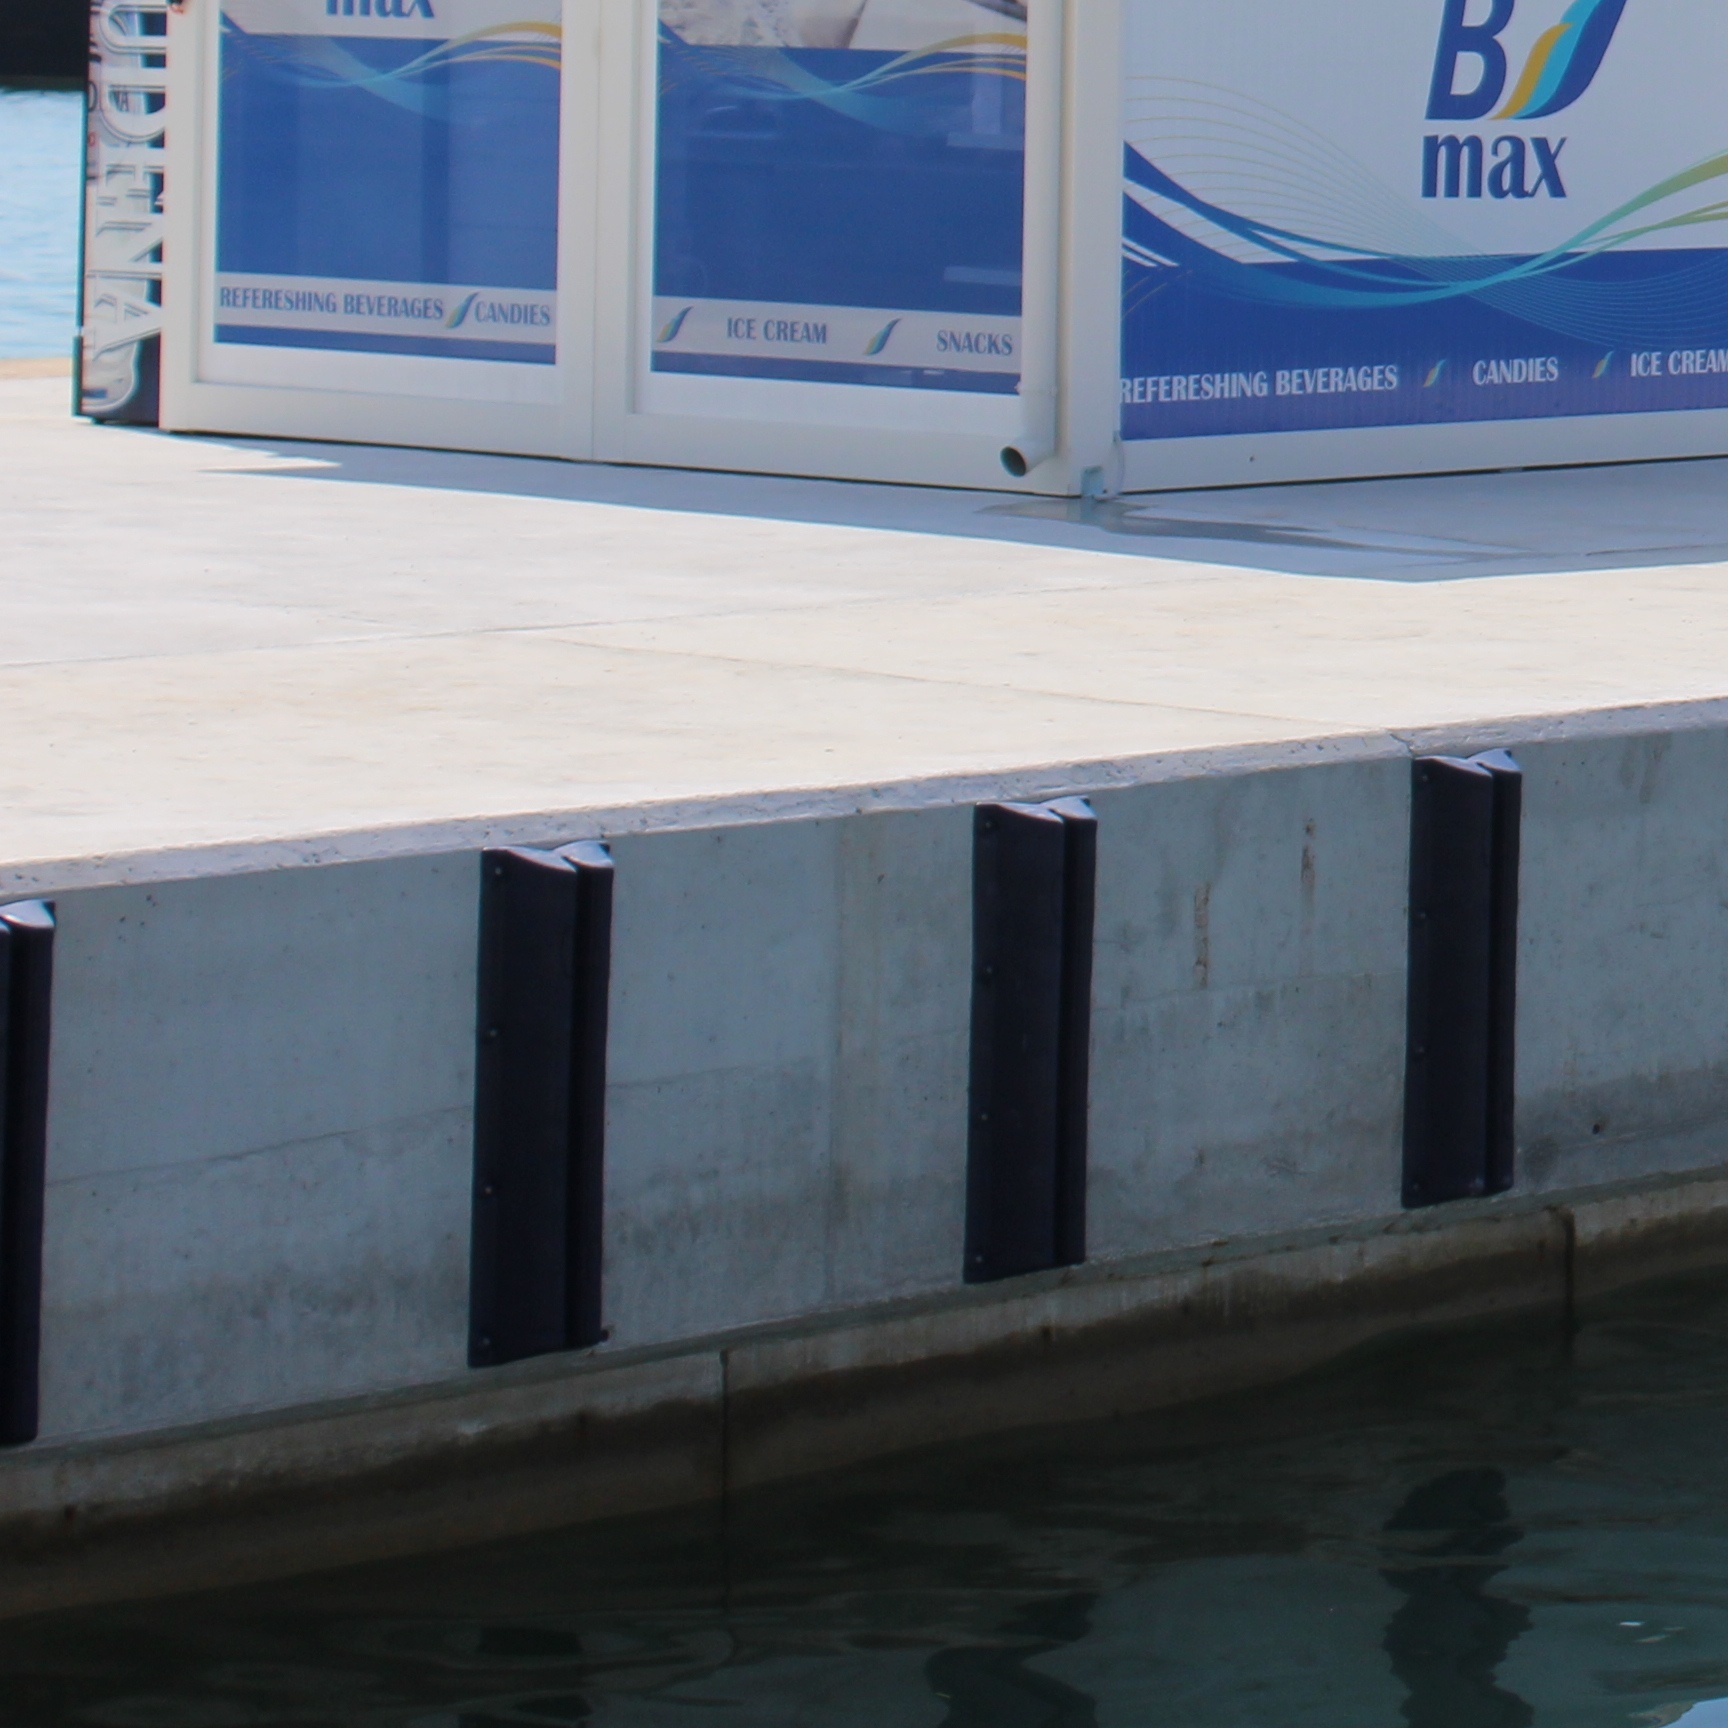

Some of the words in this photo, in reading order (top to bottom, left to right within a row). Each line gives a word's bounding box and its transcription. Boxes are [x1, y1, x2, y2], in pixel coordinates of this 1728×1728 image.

[1421, 134, 1568, 200] max
[219, 286, 338, 314] REFERESHING
[343, 293, 444, 320] BEVERAGES
[474, 300, 552, 327] CANDIES
[726, 317, 757, 340] ICE
[762, 320, 828, 345] CREAM
[936, 329, 1014, 356] SNACKS
[1120, 370, 1268, 404] REFERESHING
[1275, 364, 1398, 396] BEVERAGES
[1472, 356, 1559, 386] CANDIES
[1630, 351, 1662, 378] ICE
